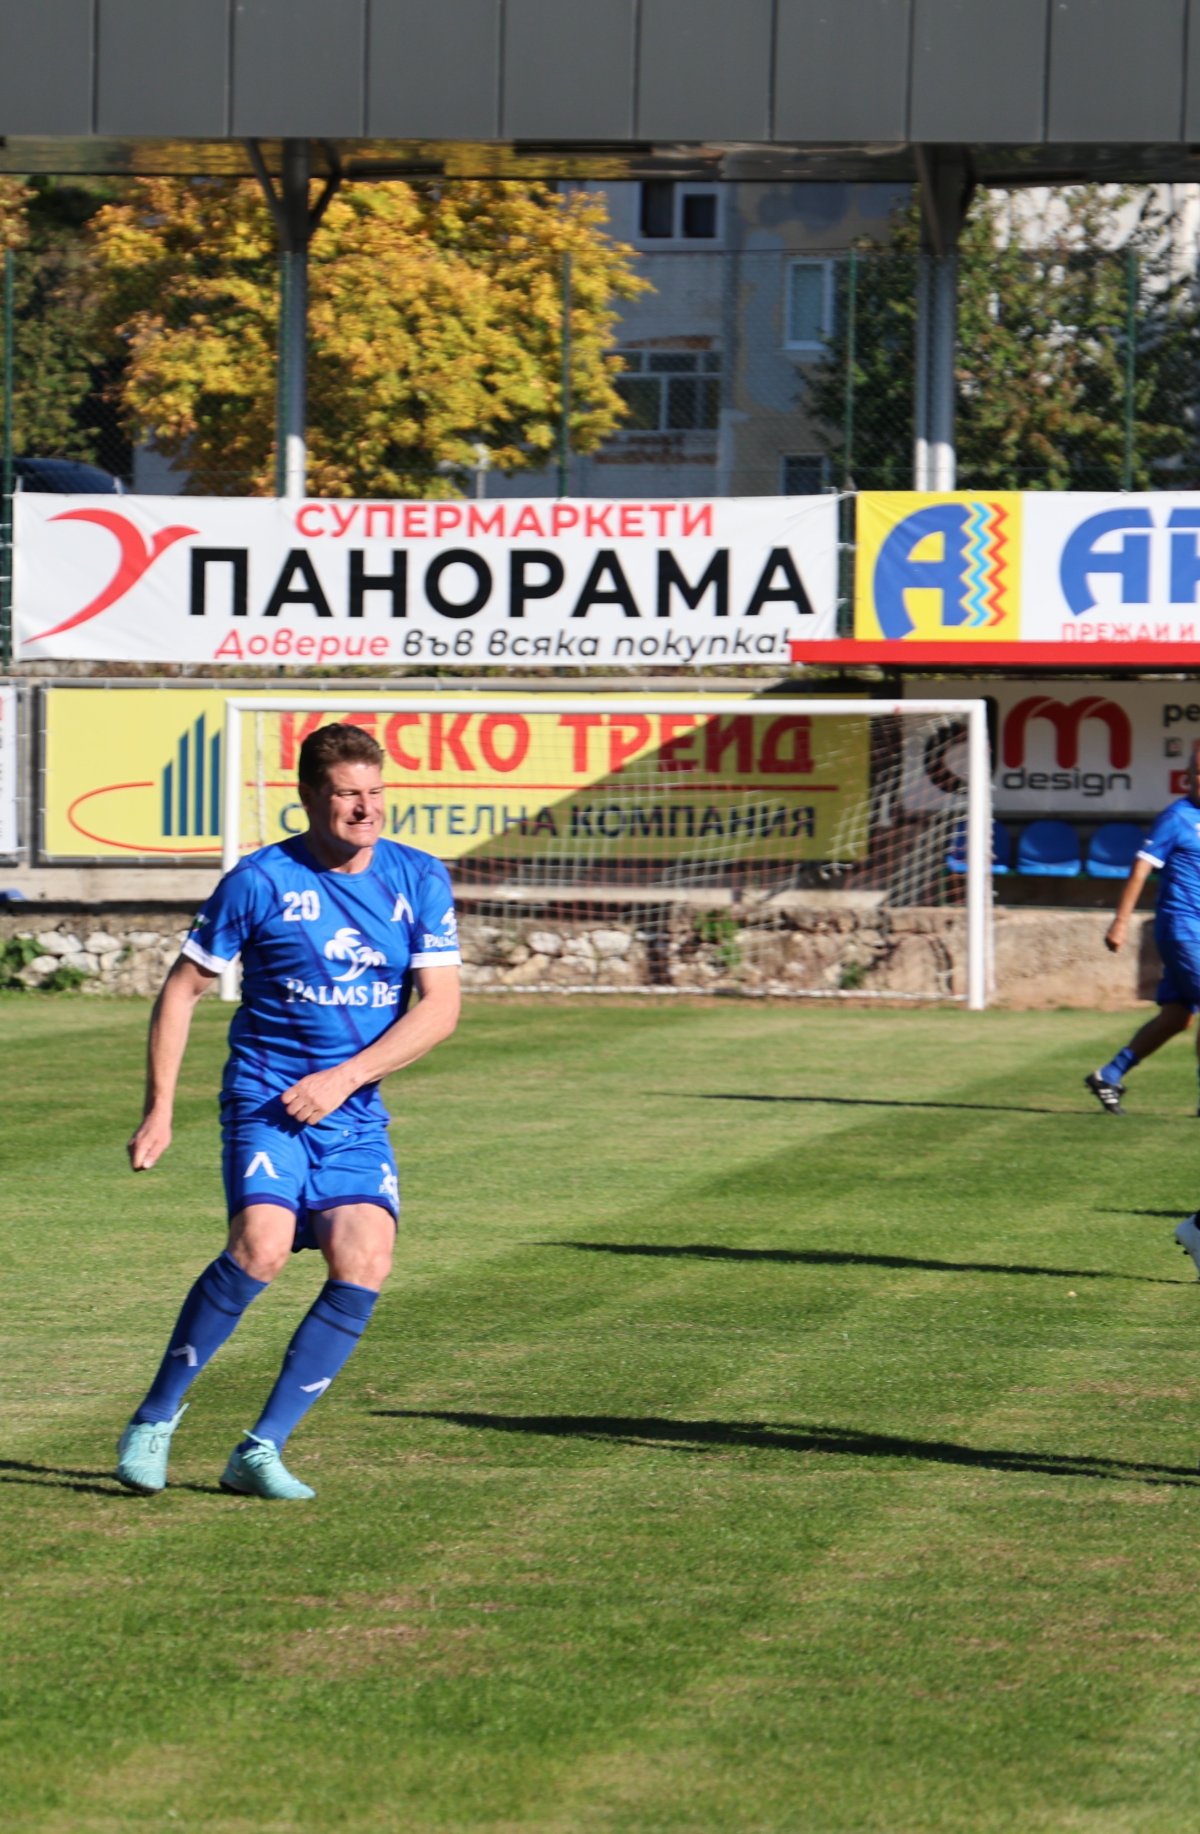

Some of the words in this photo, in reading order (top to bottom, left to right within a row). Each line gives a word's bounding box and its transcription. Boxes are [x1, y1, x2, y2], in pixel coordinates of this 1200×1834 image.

[295, 502, 713, 538] СУПЕРМАРКЕТИ
[190, 545, 815, 618] ПАНОРАМА
[213, 628, 389, 663] Доверие
[403, 628, 475, 657] във
[487, 628, 600, 656] всяка
[612, 627, 790, 663] покупка!
[1178, 622, 1196, 642] И
[1002, 767, 1132, 798] design
[570, 804, 816, 838] КОМПАНИЯ
[282, 889, 322, 923] 20
